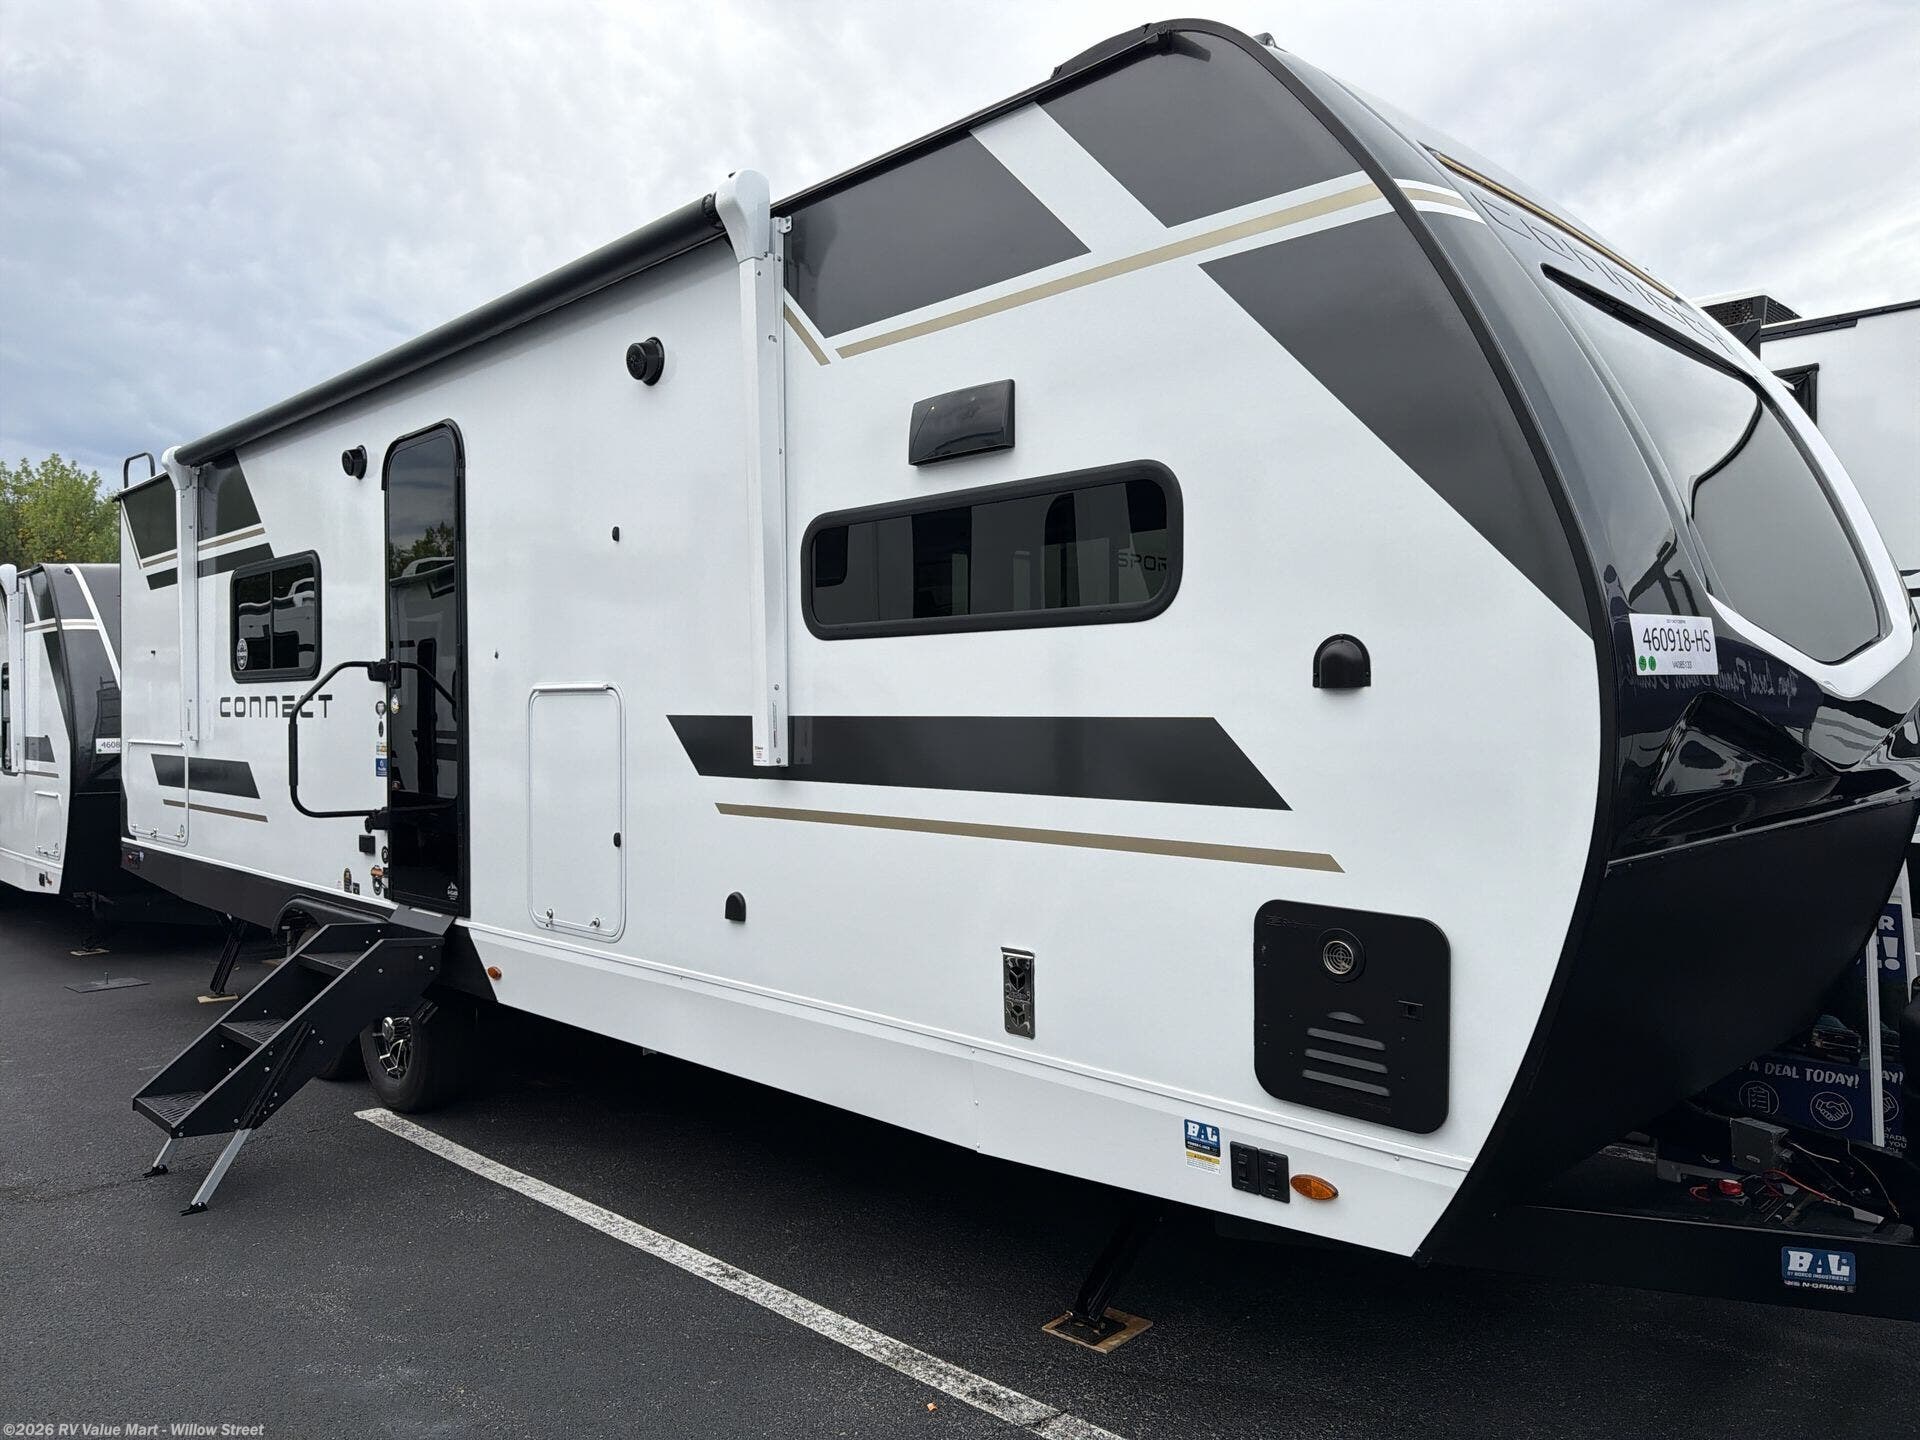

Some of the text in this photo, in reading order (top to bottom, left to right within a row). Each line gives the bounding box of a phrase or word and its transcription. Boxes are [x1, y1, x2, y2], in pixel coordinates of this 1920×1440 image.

[1642, 627, 1712, 653] 460918-HS
[219, 694, 333, 718] CONNECT
[1764, 1062, 1800, 1079] DEAL
[1804, 1067, 1860, 1089] TODAY!
